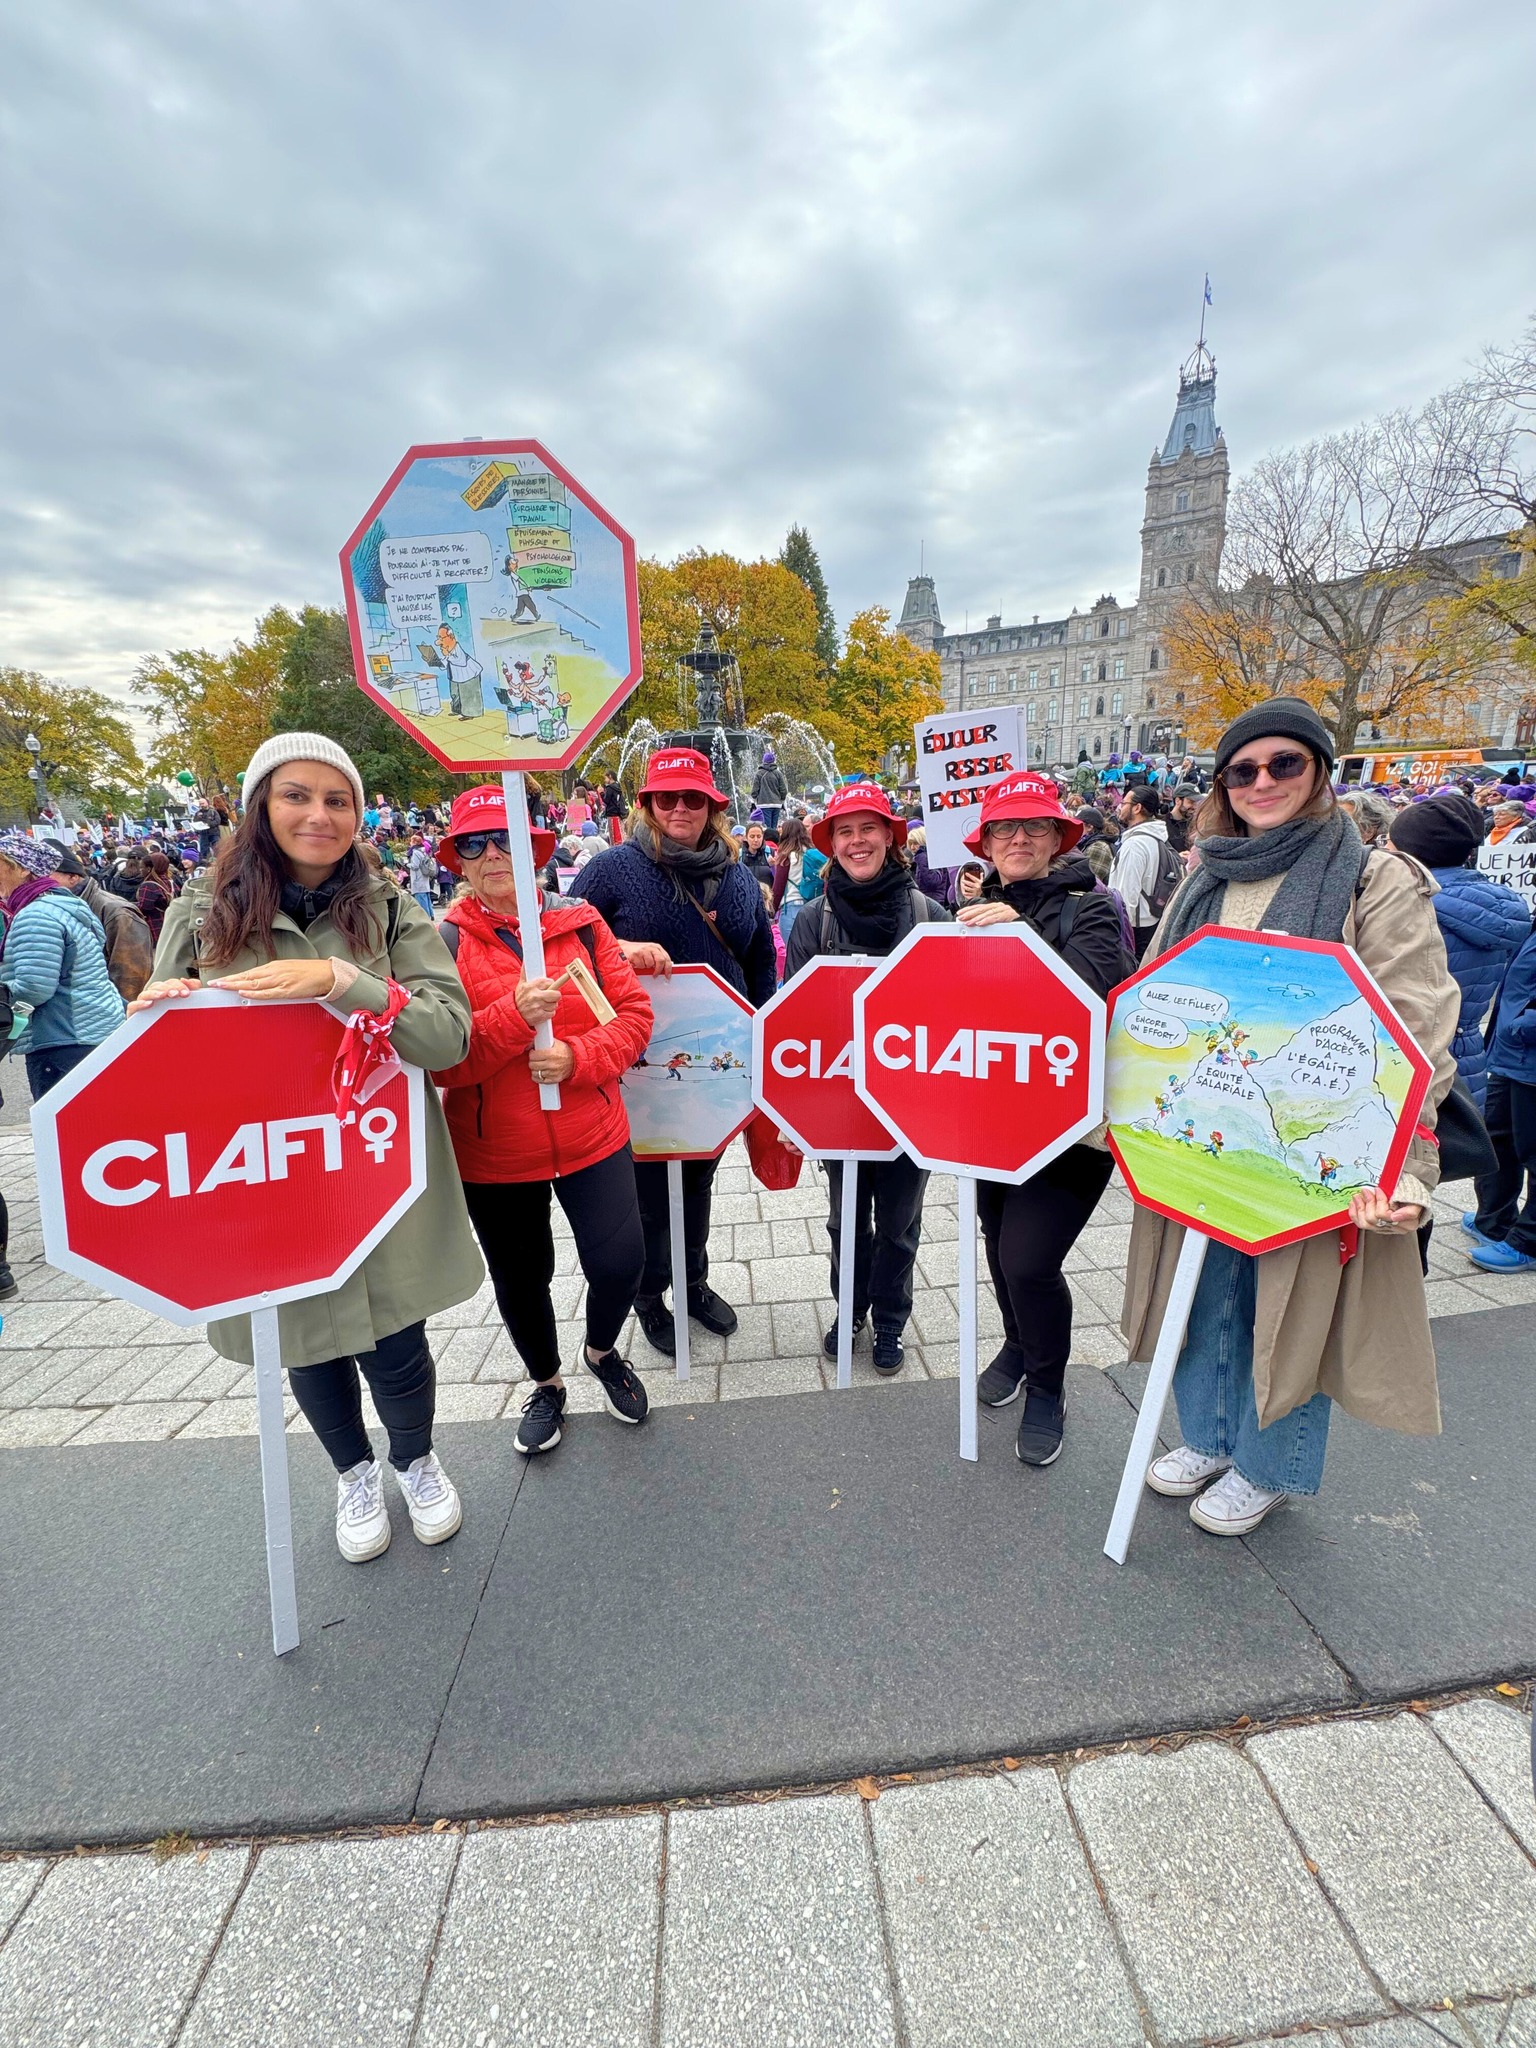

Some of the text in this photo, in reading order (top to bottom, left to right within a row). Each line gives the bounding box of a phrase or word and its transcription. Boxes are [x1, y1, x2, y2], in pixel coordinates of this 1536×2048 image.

[511, 478, 537, 486] MANQUE
[512, 487, 549, 497] PERSONNEL
[513, 503, 548, 512] SURCHARGE
[518, 515, 547, 523] TRAVAIL
[386, 544, 468, 556] JE NE COMPRENDS PAS.
[519, 539, 549, 547] PHYSIQUE
[387, 559, 419, 570] POURQUOI
[442, 559, 460, 567] TANT
[526, 553, 572, 562] PSYCHOLOGIQUE
[392, 569, 432, 581] DIFFICULTÉ
[444, 566, 489, 578] RECRUTER?
[532, 567, 564, 575] TENSIONS
[405, 593, 437, 602] POURTANT
[421, 603, 433, 611] LES
[451, 607, 458, 616] ?
[922, 724, 998, 755] ÉDUQUER
[657, 758, 690, 770] CIAFT
[1410, 761, 1439, 775] GO!
[834, 789, 866, 806] CIAFT
[998, 782, 1039, 799] CIAFT
[469, 795, 505, 808] CIAF
[928, 785, 991, 813] EXISTE
[1480, 852, 1536, 870] JE MA
[1146, 990, 1223, 1017] ALLEZ, LES FILLES!
[1135, 1015, 1167, 1028] ENCORE
[1142, 1026, 1179, 1044] EFFORT!
[1310, 1024, 1370, 1057] PROGRAMME
[872, 1023, 1043, 1084] CIAFT
[1315, 1038, 1354, 1056] D'ACCÈS
[770, 1038, 855, 1080] CIA
[1288, 1052, 1357, 1077] L'ÉGALITÉ
[1206, 1067, 1244, 1085] EQUITÉ
[1196, 1075, 1256, 1100] SALARIALE
[81, 1110, 356, 1207] CIAFT
